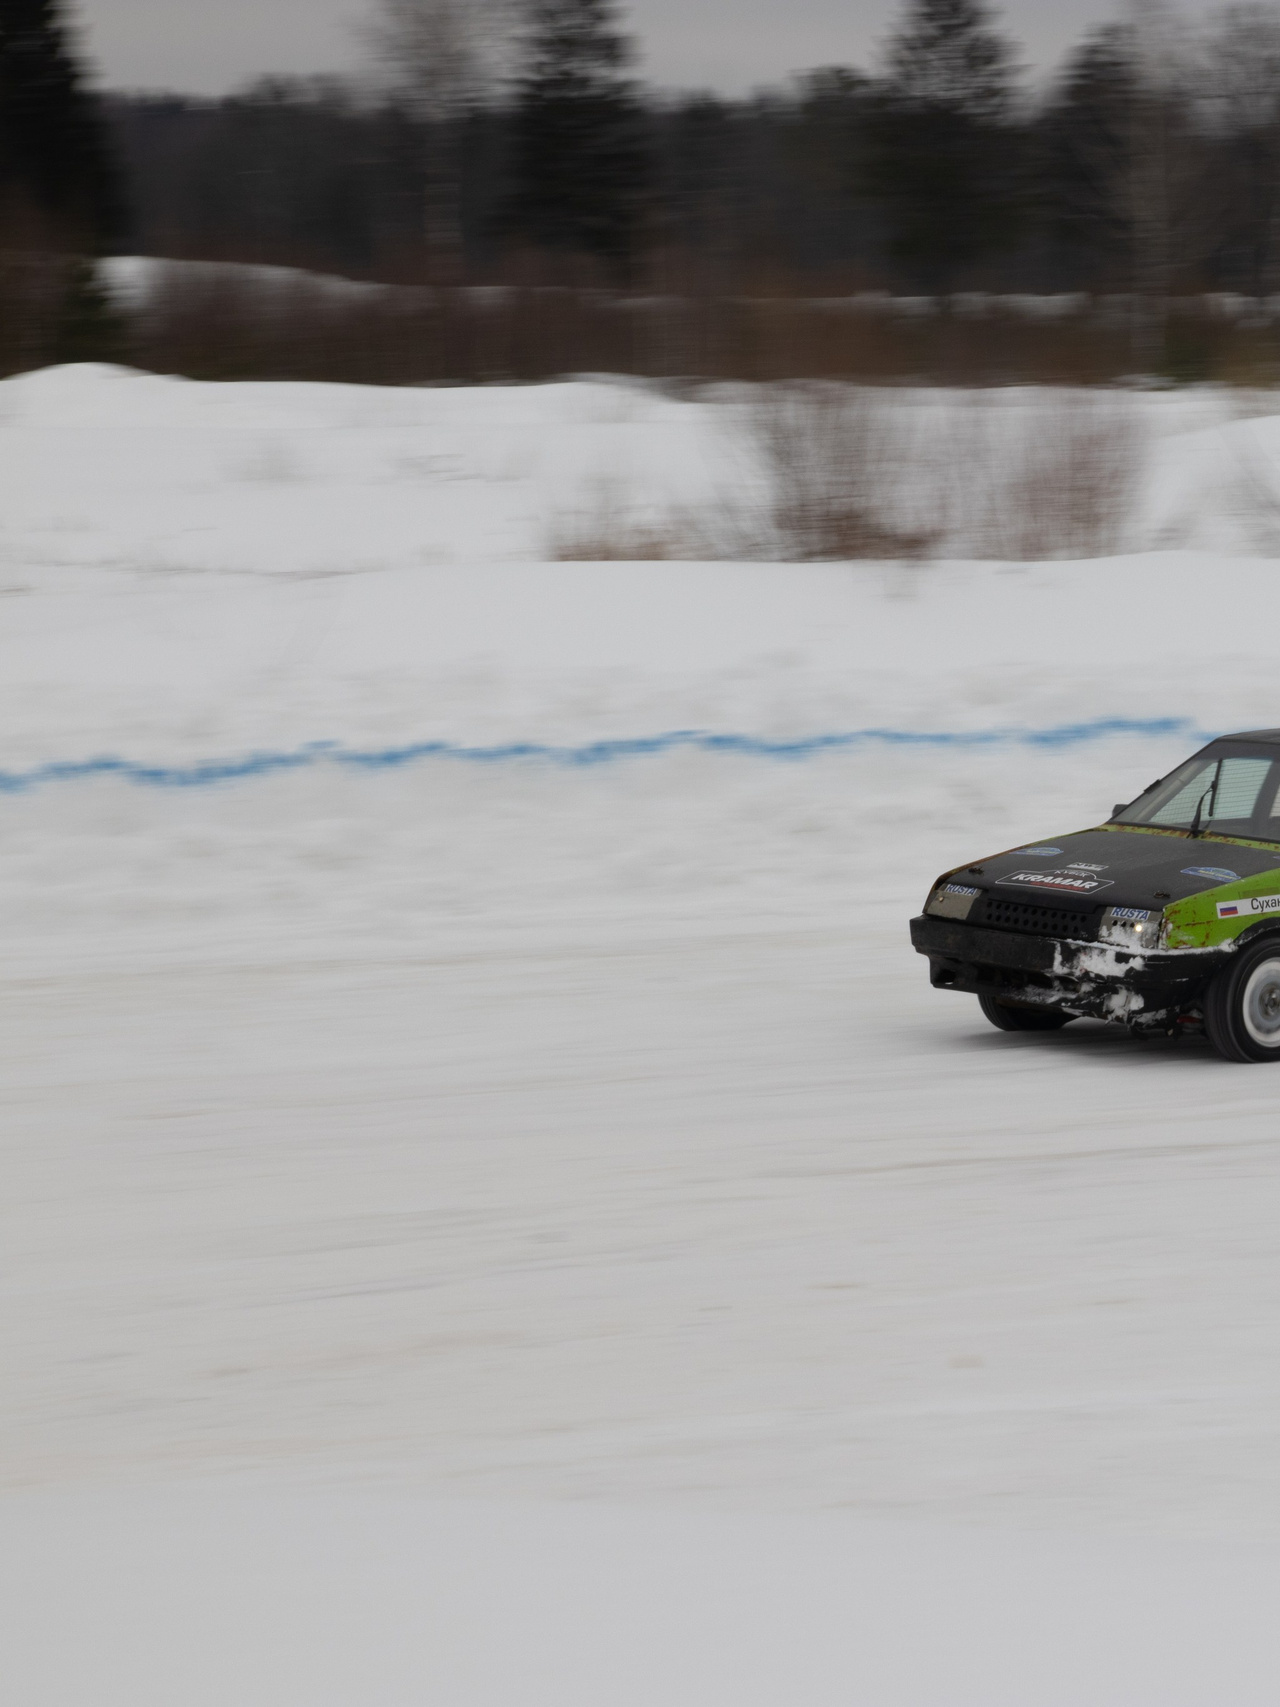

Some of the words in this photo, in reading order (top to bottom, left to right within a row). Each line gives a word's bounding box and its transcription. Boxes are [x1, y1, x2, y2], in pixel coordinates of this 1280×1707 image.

[1011, 873, 1098, 889] KRAMAR
[947, 884, 976, 896] RUSTA
[1112, 907, 1149, 920] RUSTA
